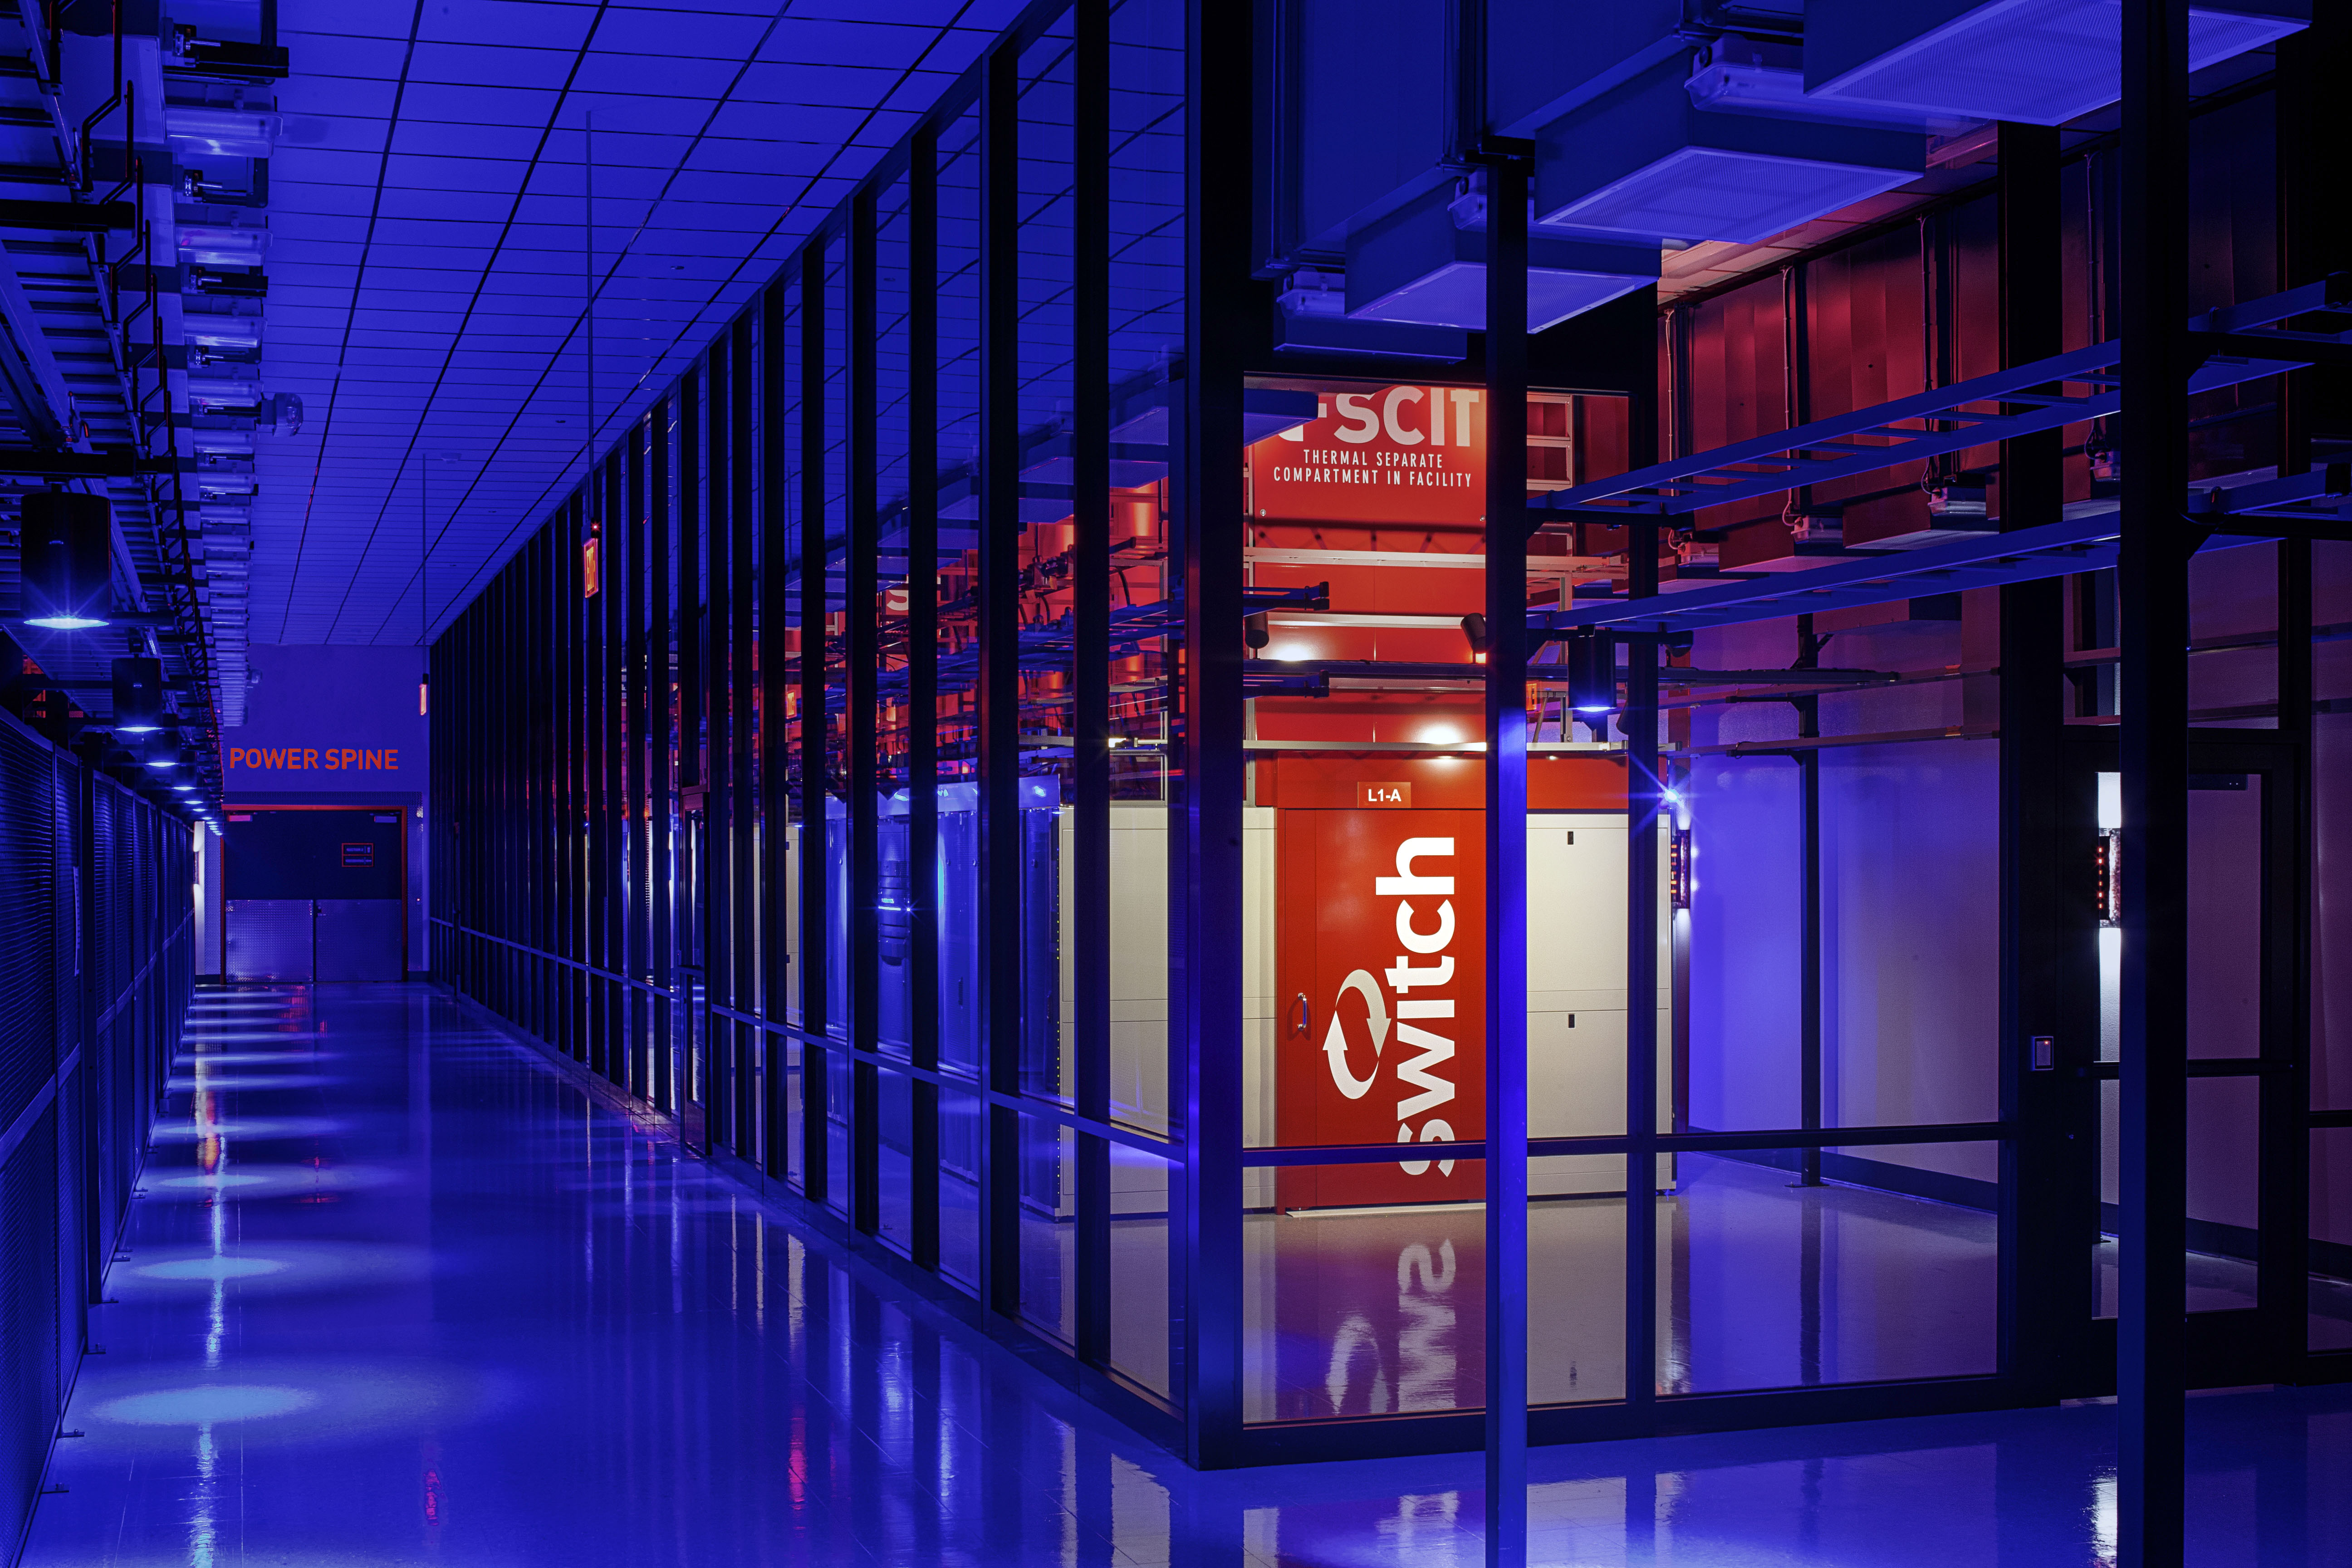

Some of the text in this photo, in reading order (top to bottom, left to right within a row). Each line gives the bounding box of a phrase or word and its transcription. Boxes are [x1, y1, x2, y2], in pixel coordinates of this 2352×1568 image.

[1303, 449, 1443, 468] THERMAL SEPARATE
[1274, 466, 1471, 487] COMPARTMENT IN FACILITY
[230, 748, 398, 770] POWER SPINE
[1368, 789, 1402, 802] L1-A
[1375, 837, 1455, 1177] switch
